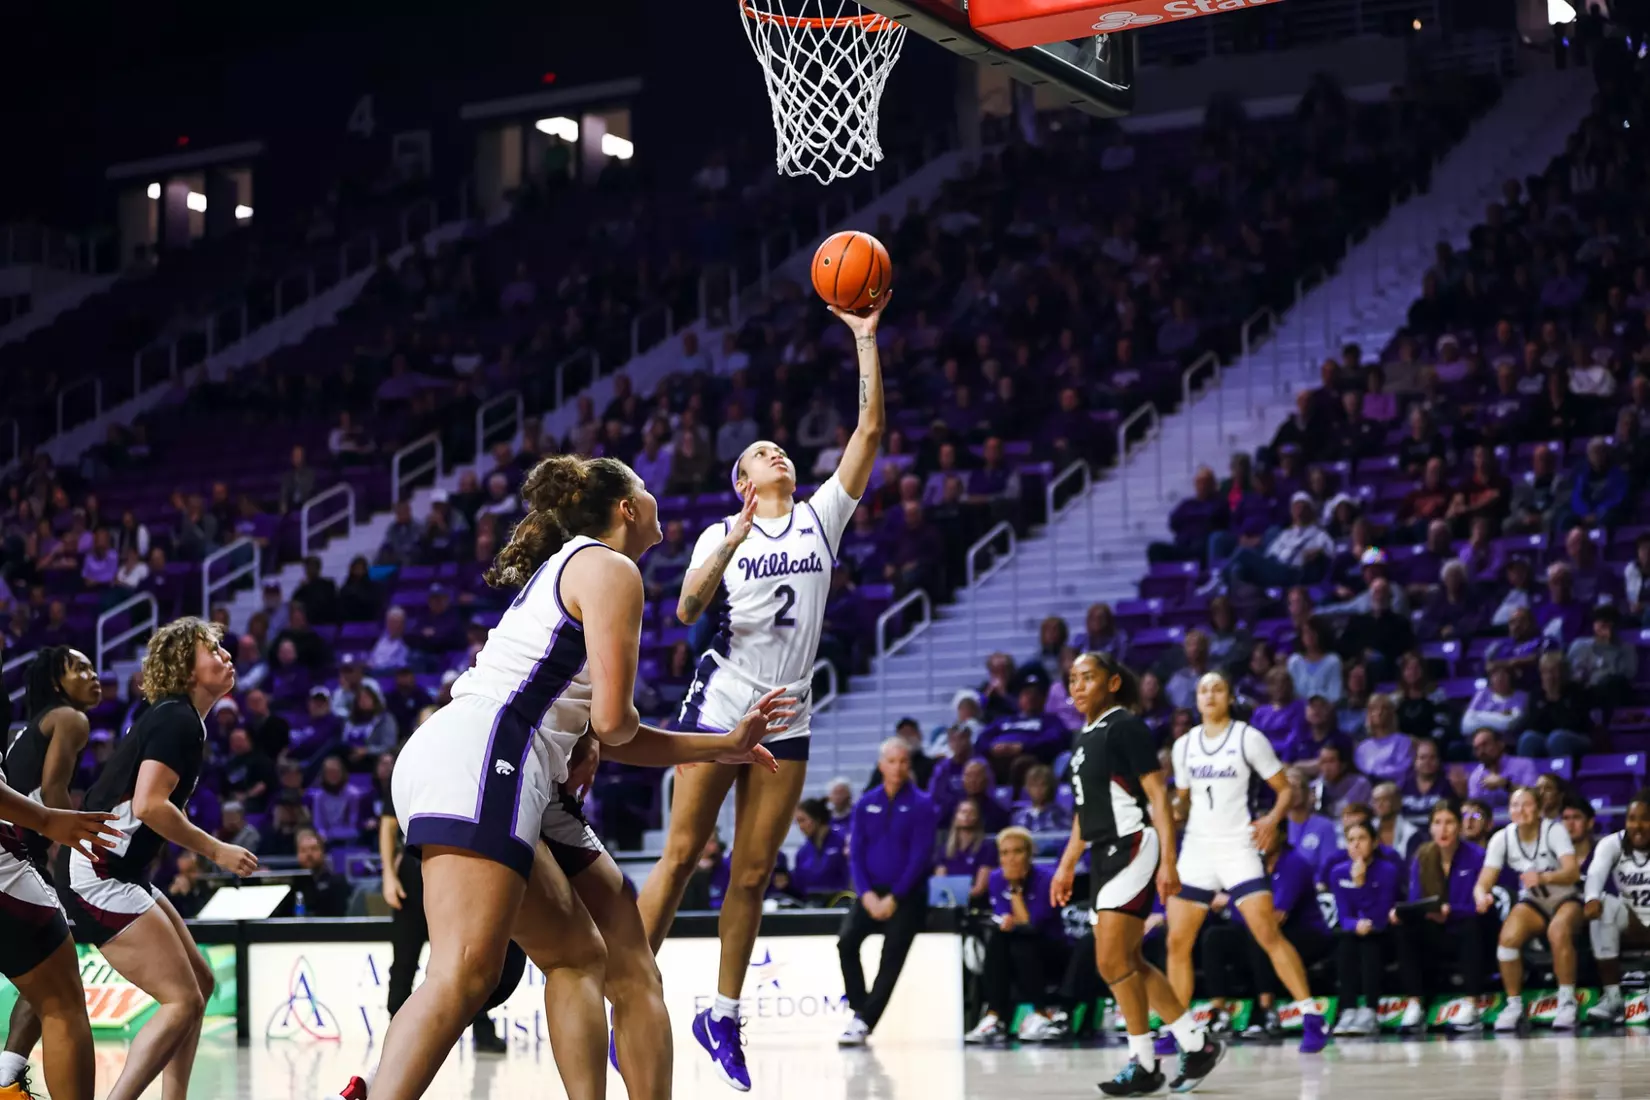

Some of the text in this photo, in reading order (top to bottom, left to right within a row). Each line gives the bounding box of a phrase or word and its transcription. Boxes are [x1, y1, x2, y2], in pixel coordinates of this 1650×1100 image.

[1163, 0, 1268, 18] Sta
[346, 93, 376, 139] 4
[738, 551, 823, 580] Wildcats
[774, 585, 796, 627] 2
[1206, 784, 1214, 811] 1
[694, 994, 851, 1019] FEEDOM
